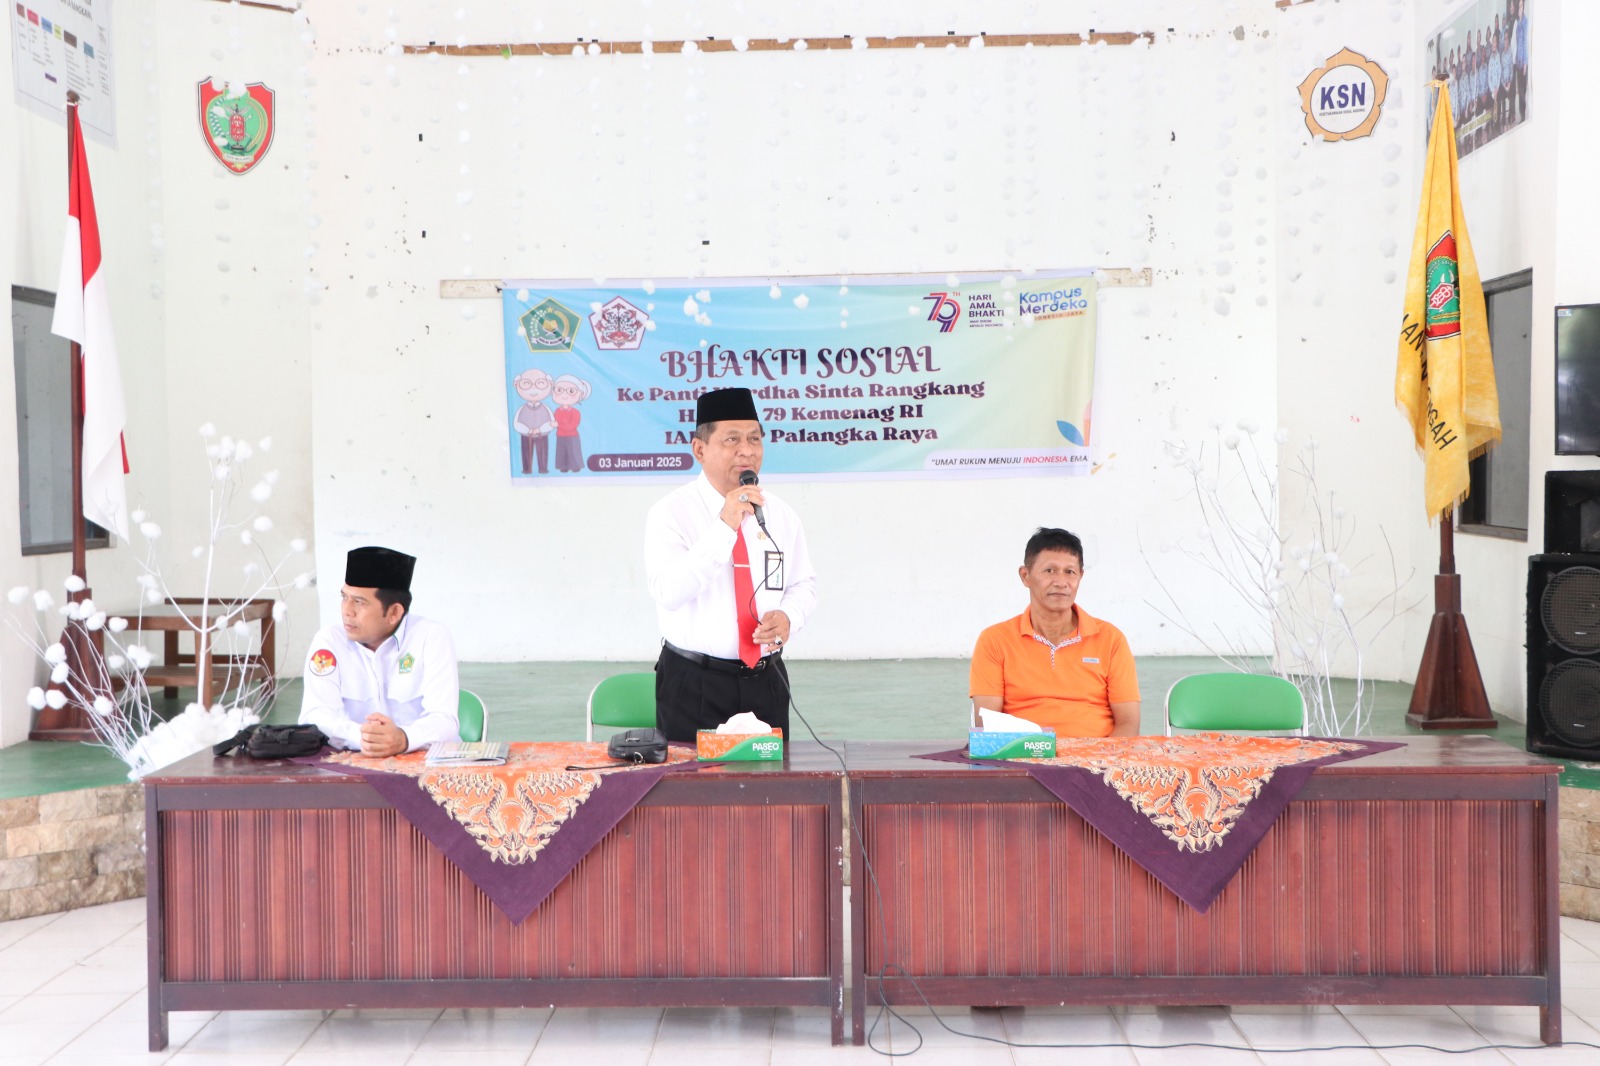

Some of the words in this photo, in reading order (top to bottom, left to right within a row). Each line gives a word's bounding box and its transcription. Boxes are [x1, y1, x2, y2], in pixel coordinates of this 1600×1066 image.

[1321, 82, 1365, 110] KSN
[1020, 288, 1082, 304] Kampus
[1020, 299, 1088, 316] Merdeka
[660, 344, 807, 383] BHAKTI
[816, 345, 941, 379] SOSIAL
[617, 388, 645, 401] Ke
[649, 386, 708, 401] Panti
[805, 383, 864, 399] Sinta
[869, 381, 985, 400] Rangkang
[763, 407, 787, 421] 79
[791, 406, 895, 422] Kemenag
[899, 404, 924, 418] RI
[770, 427, 878, 446] Palangka
[883, 427, 938, 444] Raya
[599, 458, 611, 468] 03
[614, 457, 654, 468] Januari
[656, 457, 682, 467] 2025
[988, 457, 1021, 465] MENUJU
[1023, 456, 1068, 464] INDONESIA
[752, 742, 779, 751] PASEO
[1024, 741, 1052, 750] PASEO
